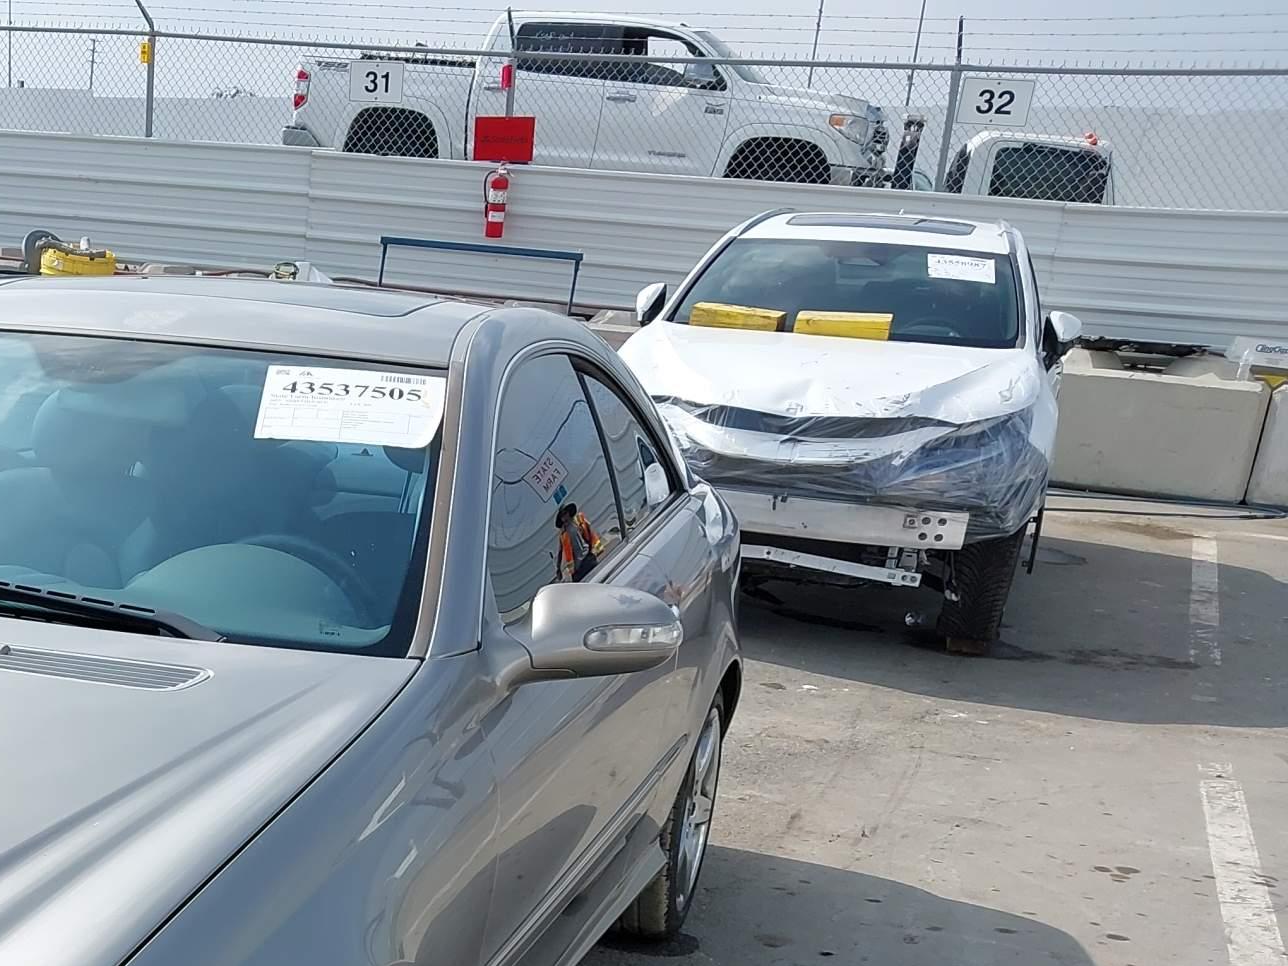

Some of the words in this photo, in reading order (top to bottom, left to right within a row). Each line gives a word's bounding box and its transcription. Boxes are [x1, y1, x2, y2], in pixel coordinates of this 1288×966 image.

[364, 71, 390, 93] 31
[975, 88, 1015, 115] 32
[282, 380, 423, 402] 43537505
